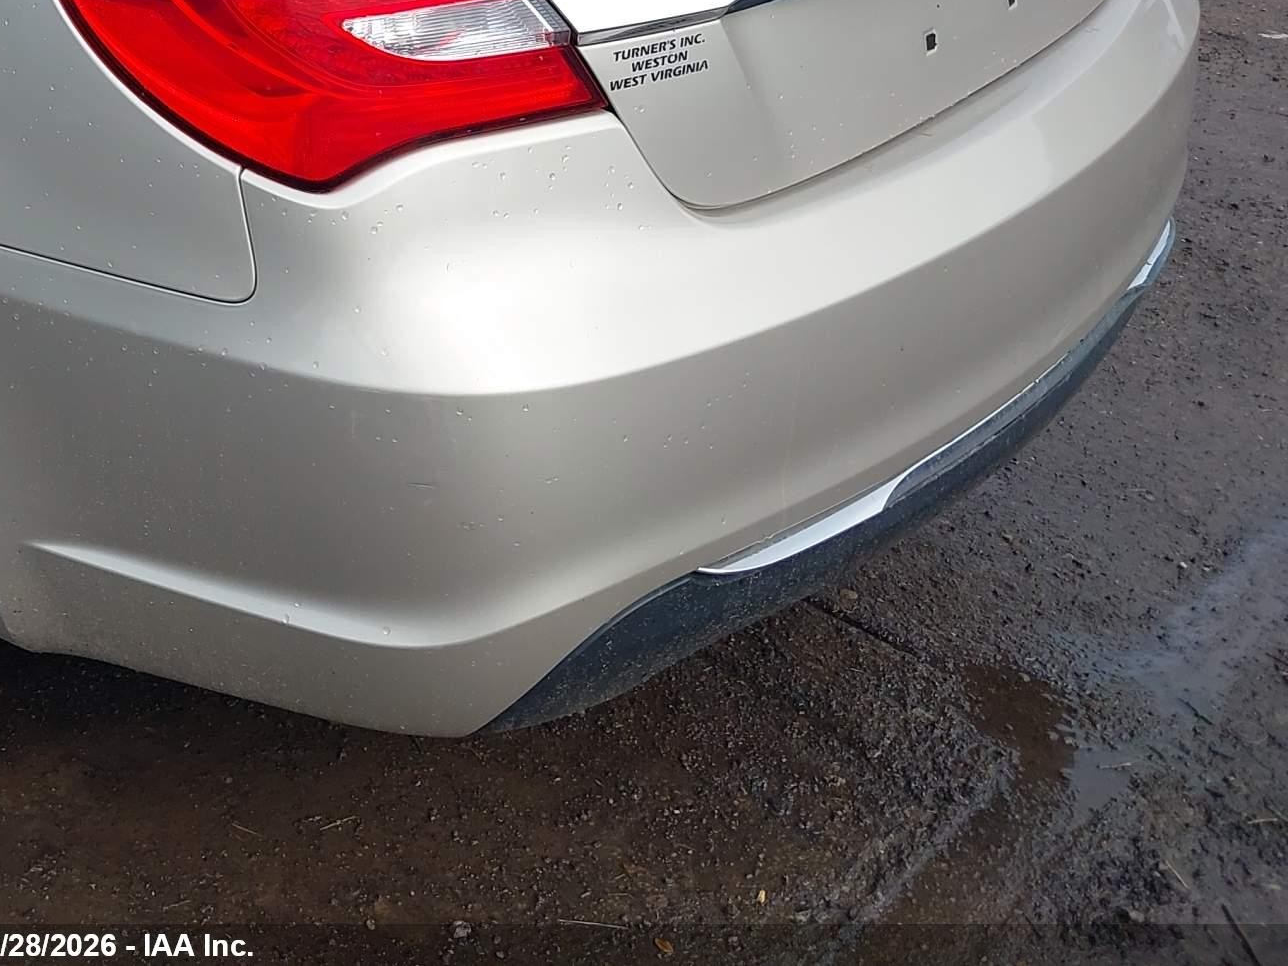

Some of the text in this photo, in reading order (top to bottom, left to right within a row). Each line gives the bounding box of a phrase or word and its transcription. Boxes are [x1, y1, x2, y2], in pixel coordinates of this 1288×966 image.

[613, 33, 706, 62] TURNER'S INC.
[631, 50, 688, 72] WESTON
[609, 60, 709, 91] WEST VIRGINIA
